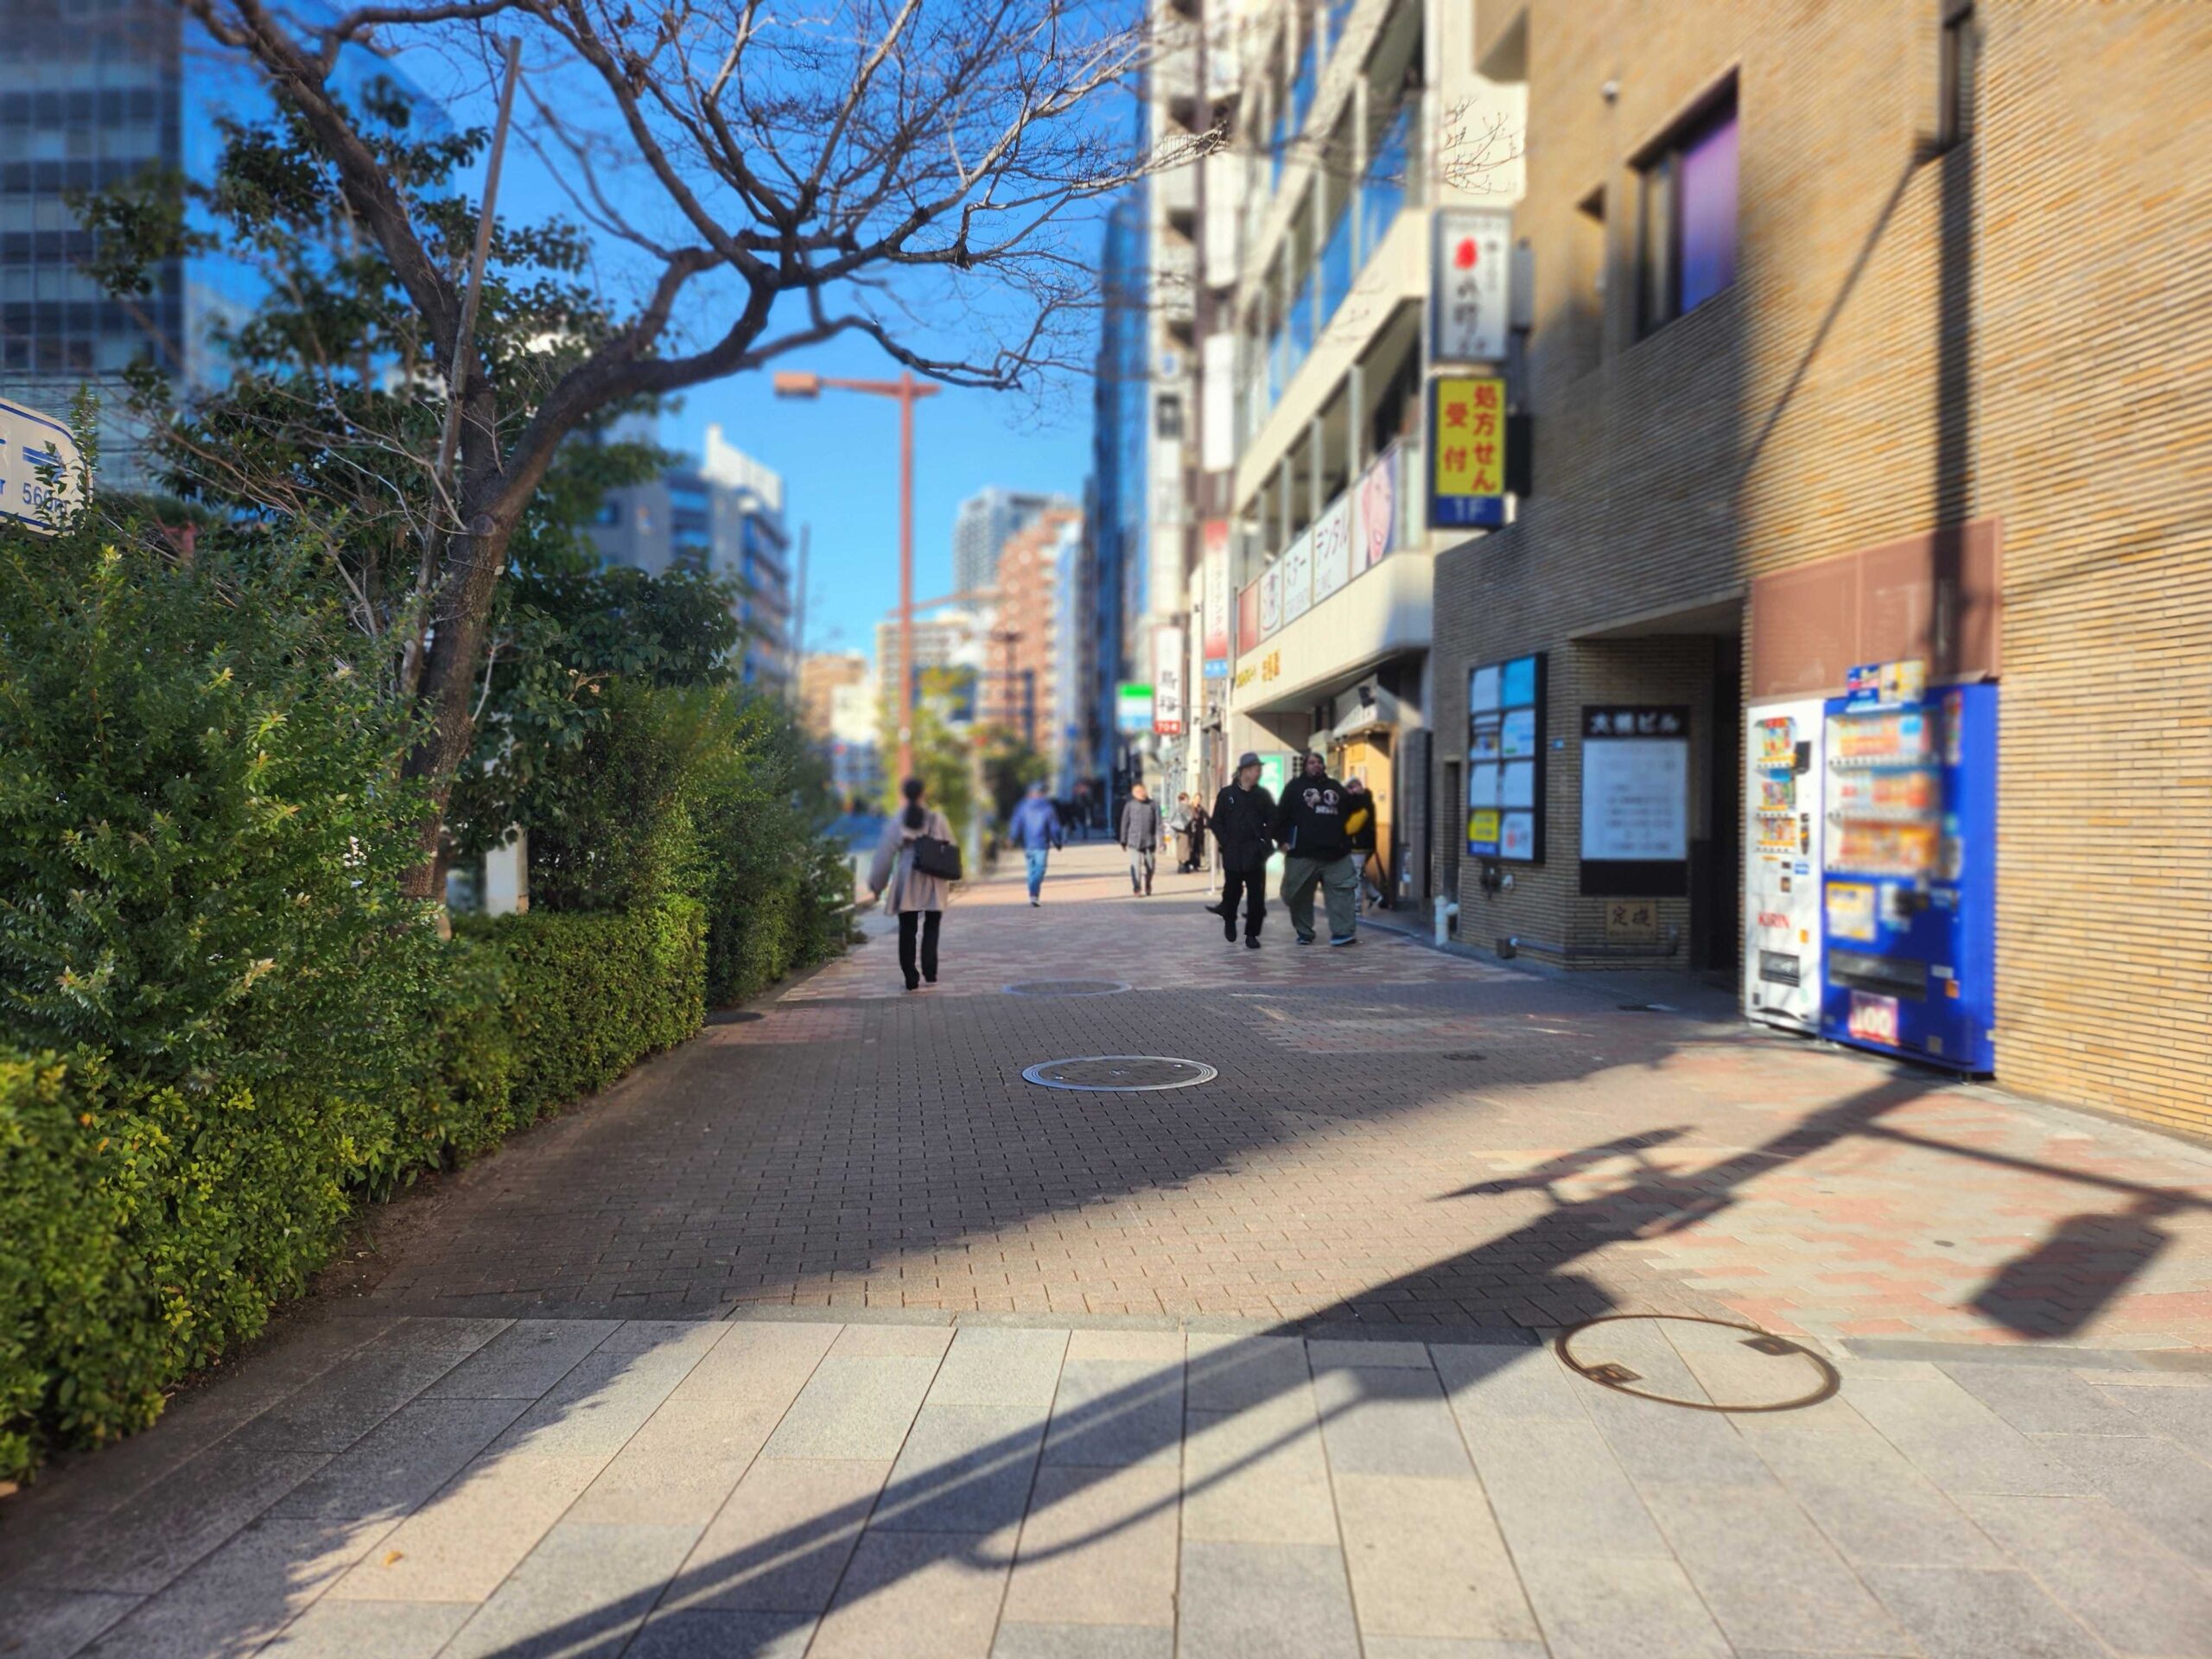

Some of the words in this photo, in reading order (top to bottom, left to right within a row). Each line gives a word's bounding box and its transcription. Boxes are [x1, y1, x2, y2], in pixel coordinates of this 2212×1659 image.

[1444, 403, 1467, 472] 受付
[1472, 383, 1497, 493] 処方せん
[1758, 912, 1790, 929] KIRIN
